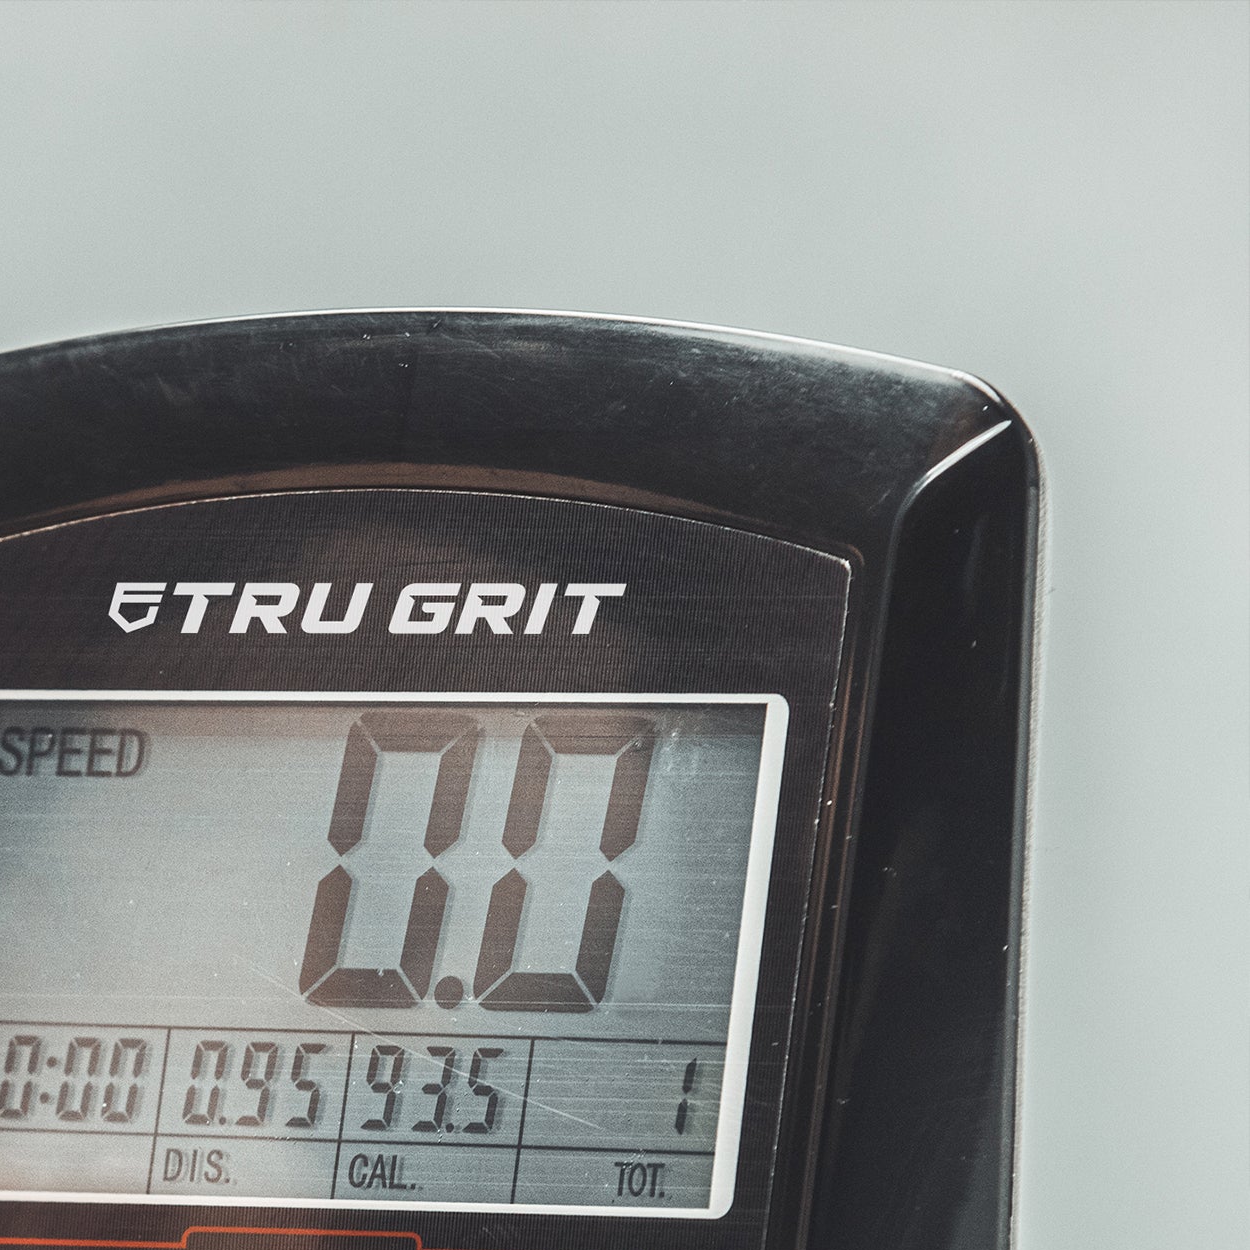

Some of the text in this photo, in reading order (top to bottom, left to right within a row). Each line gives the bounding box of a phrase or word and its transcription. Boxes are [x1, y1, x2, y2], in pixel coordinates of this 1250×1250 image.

[172, 582, 628, 635] TRU GRIT
[299, 710, 654, 1013] 0.0
[182, 1040, 326, 1128] 0.95
[360, 1044, 504, 1134] 93.5
[674, 1057, 698, 1135] 1
[162, 1148, 231, 1184] DIS.
[348, 1153, 418, 1191] CAL.
[614, 1161, 667, 1198] TOT.
